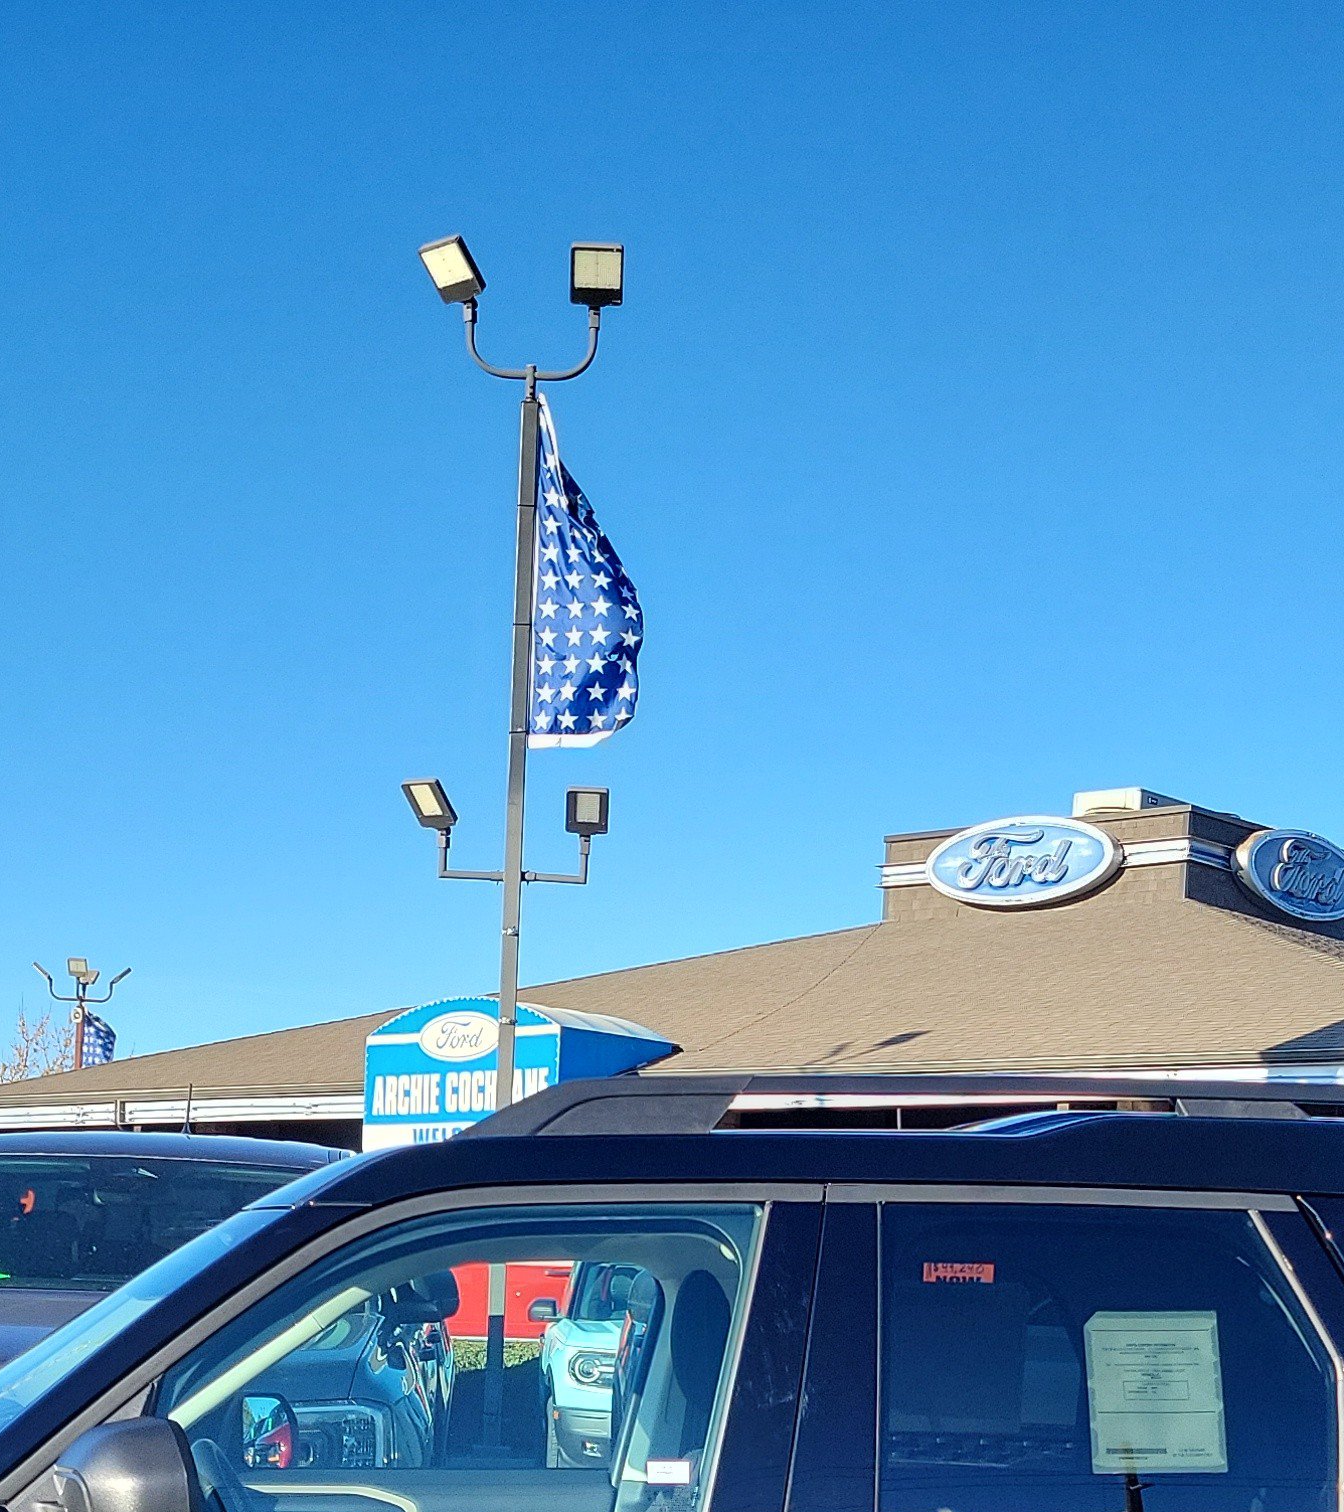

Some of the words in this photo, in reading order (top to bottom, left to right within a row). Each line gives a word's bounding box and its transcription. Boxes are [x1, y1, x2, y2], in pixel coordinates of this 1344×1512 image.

[957, 829, 1073, 890] Ford
[436, 1021, 484, 1050] Ford
[371, 1073, 441, 1116] ARCHIE
[445, 1066, 550, 1113] COCHANE
